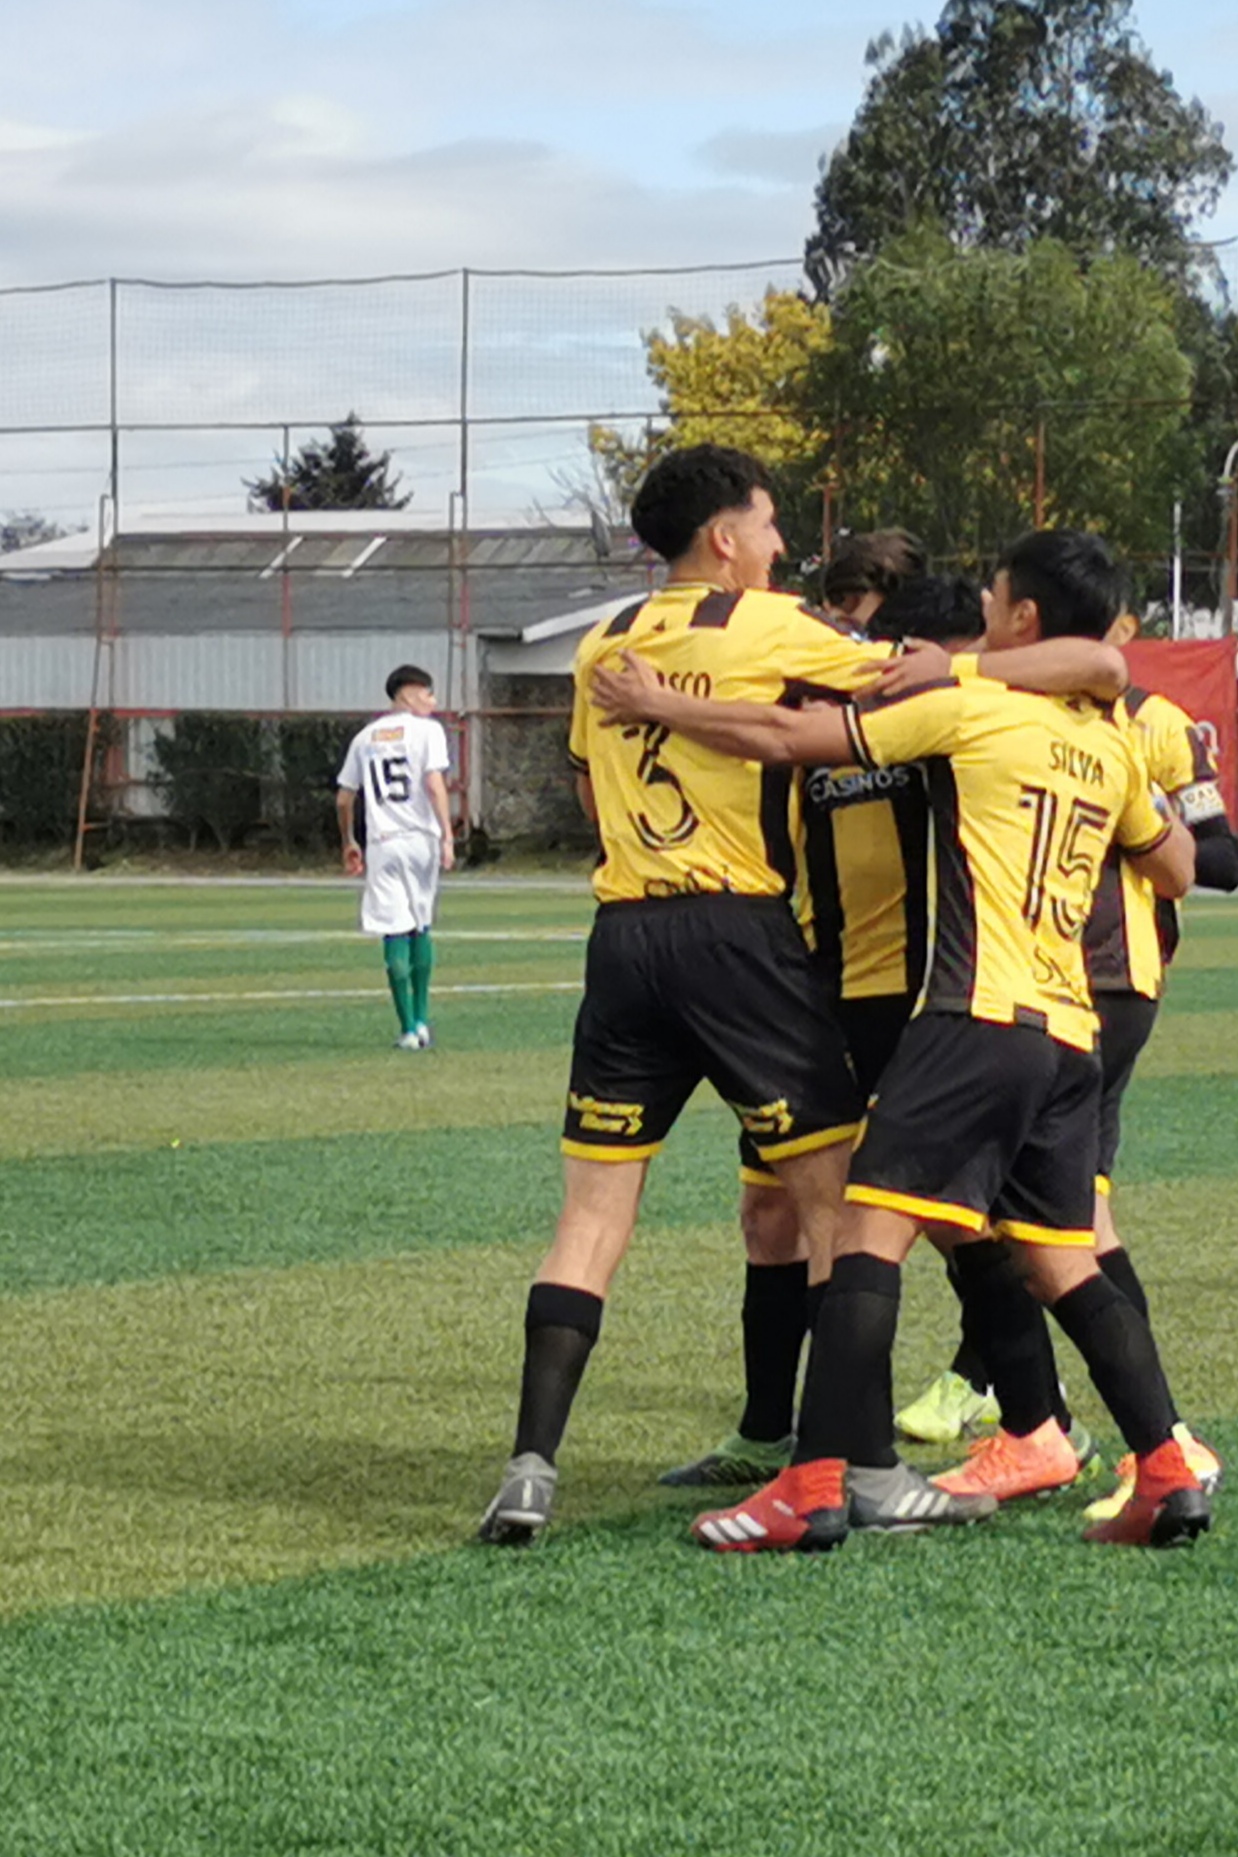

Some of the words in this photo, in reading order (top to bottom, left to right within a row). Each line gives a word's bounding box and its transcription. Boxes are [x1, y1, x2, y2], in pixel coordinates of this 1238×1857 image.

[369, 756, 411, 807] 15
[1049, 740, 1105, 789] SILVA
[1018, 784, 1111, 942] 15
